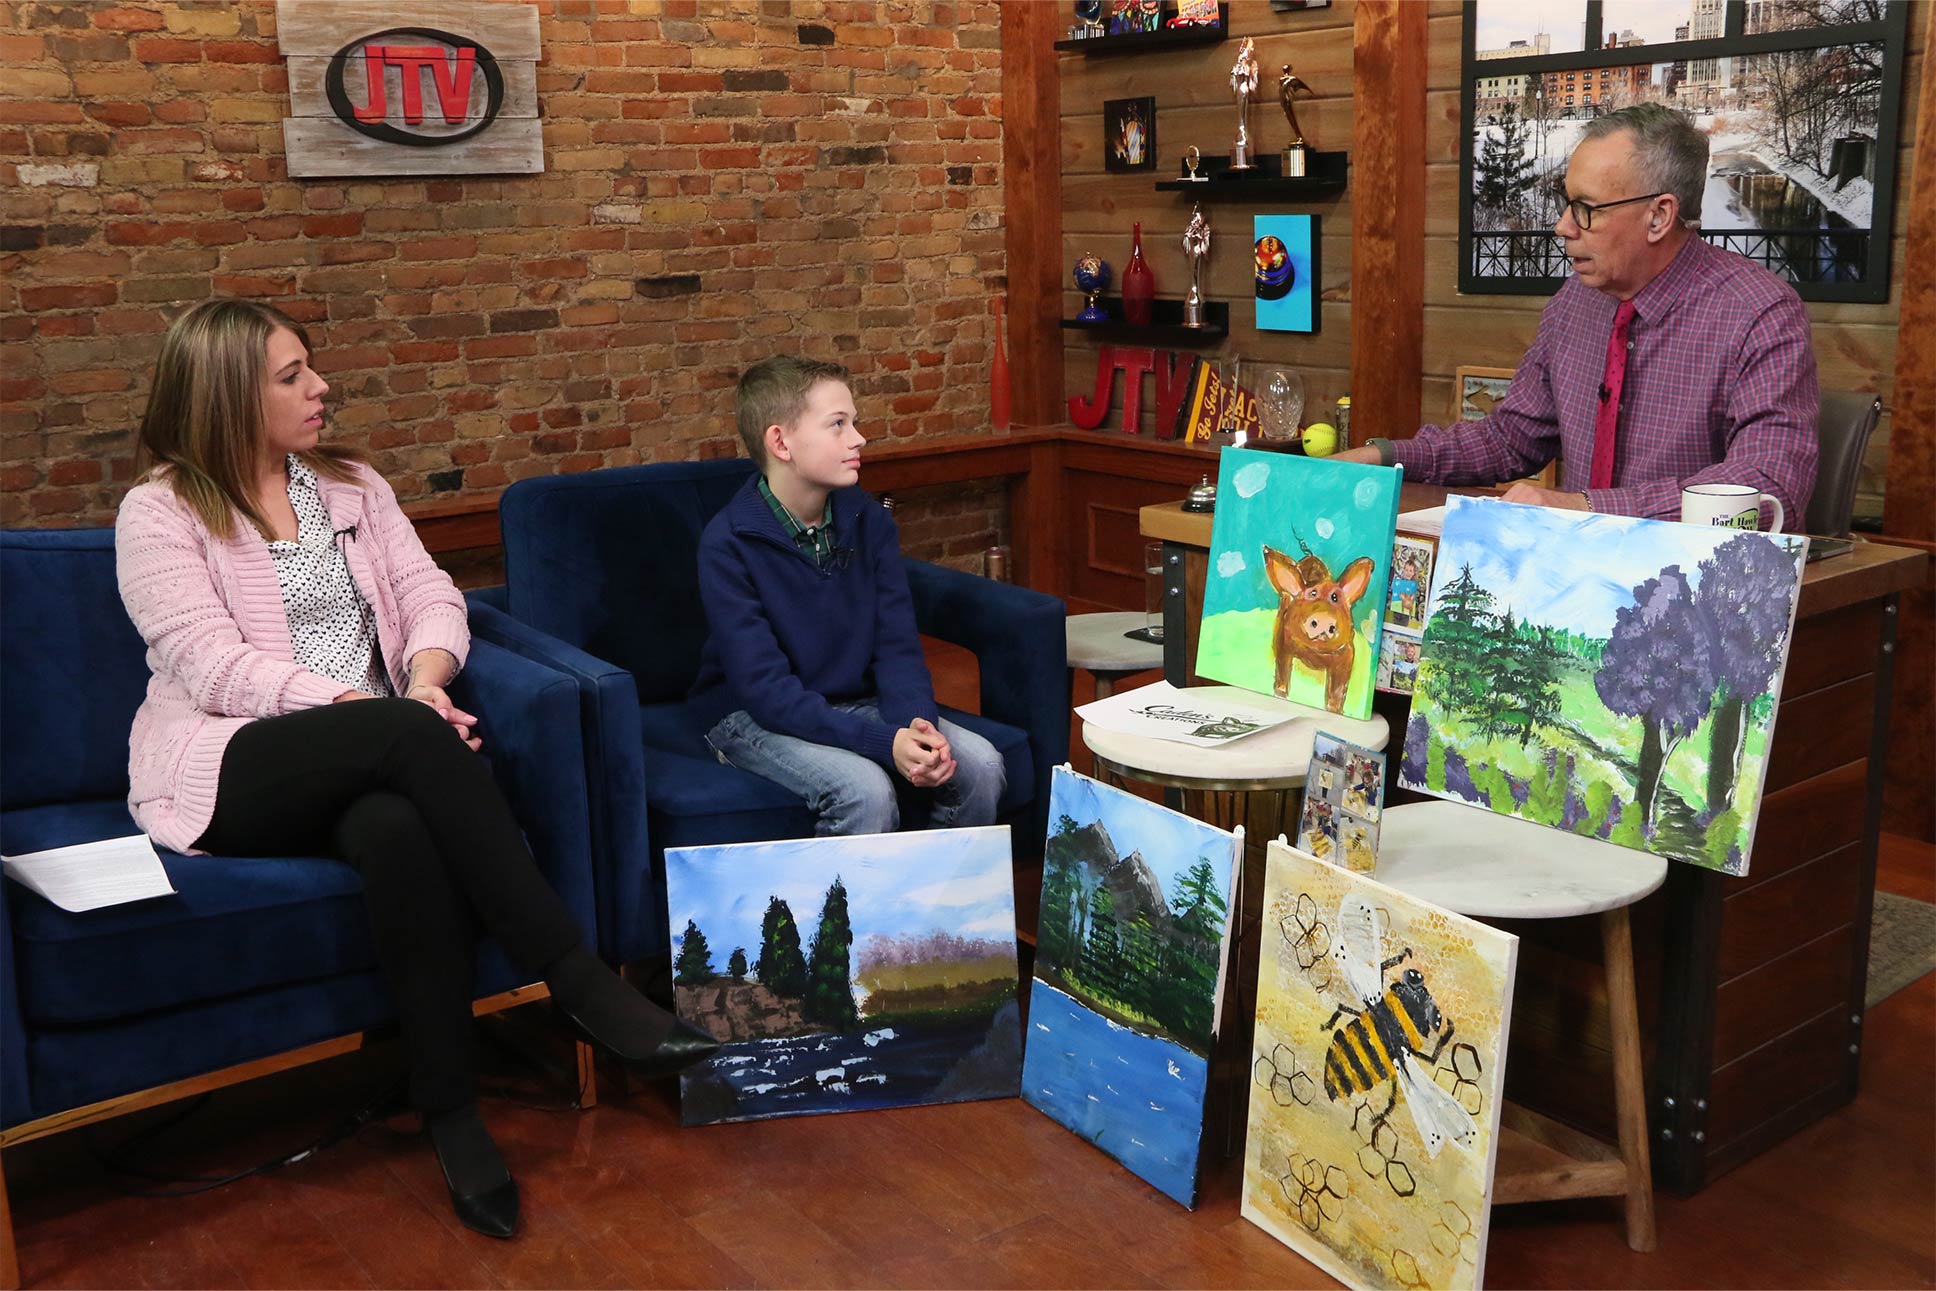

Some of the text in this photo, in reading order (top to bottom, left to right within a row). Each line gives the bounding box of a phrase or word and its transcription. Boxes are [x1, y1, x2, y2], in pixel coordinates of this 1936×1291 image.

[353, 45, 476, 125] JTV
[1068, 347, 1197, 439] JTV
[1197, 417, 1212, 440] Go
[1712, 517, 1733, 526] Bart
